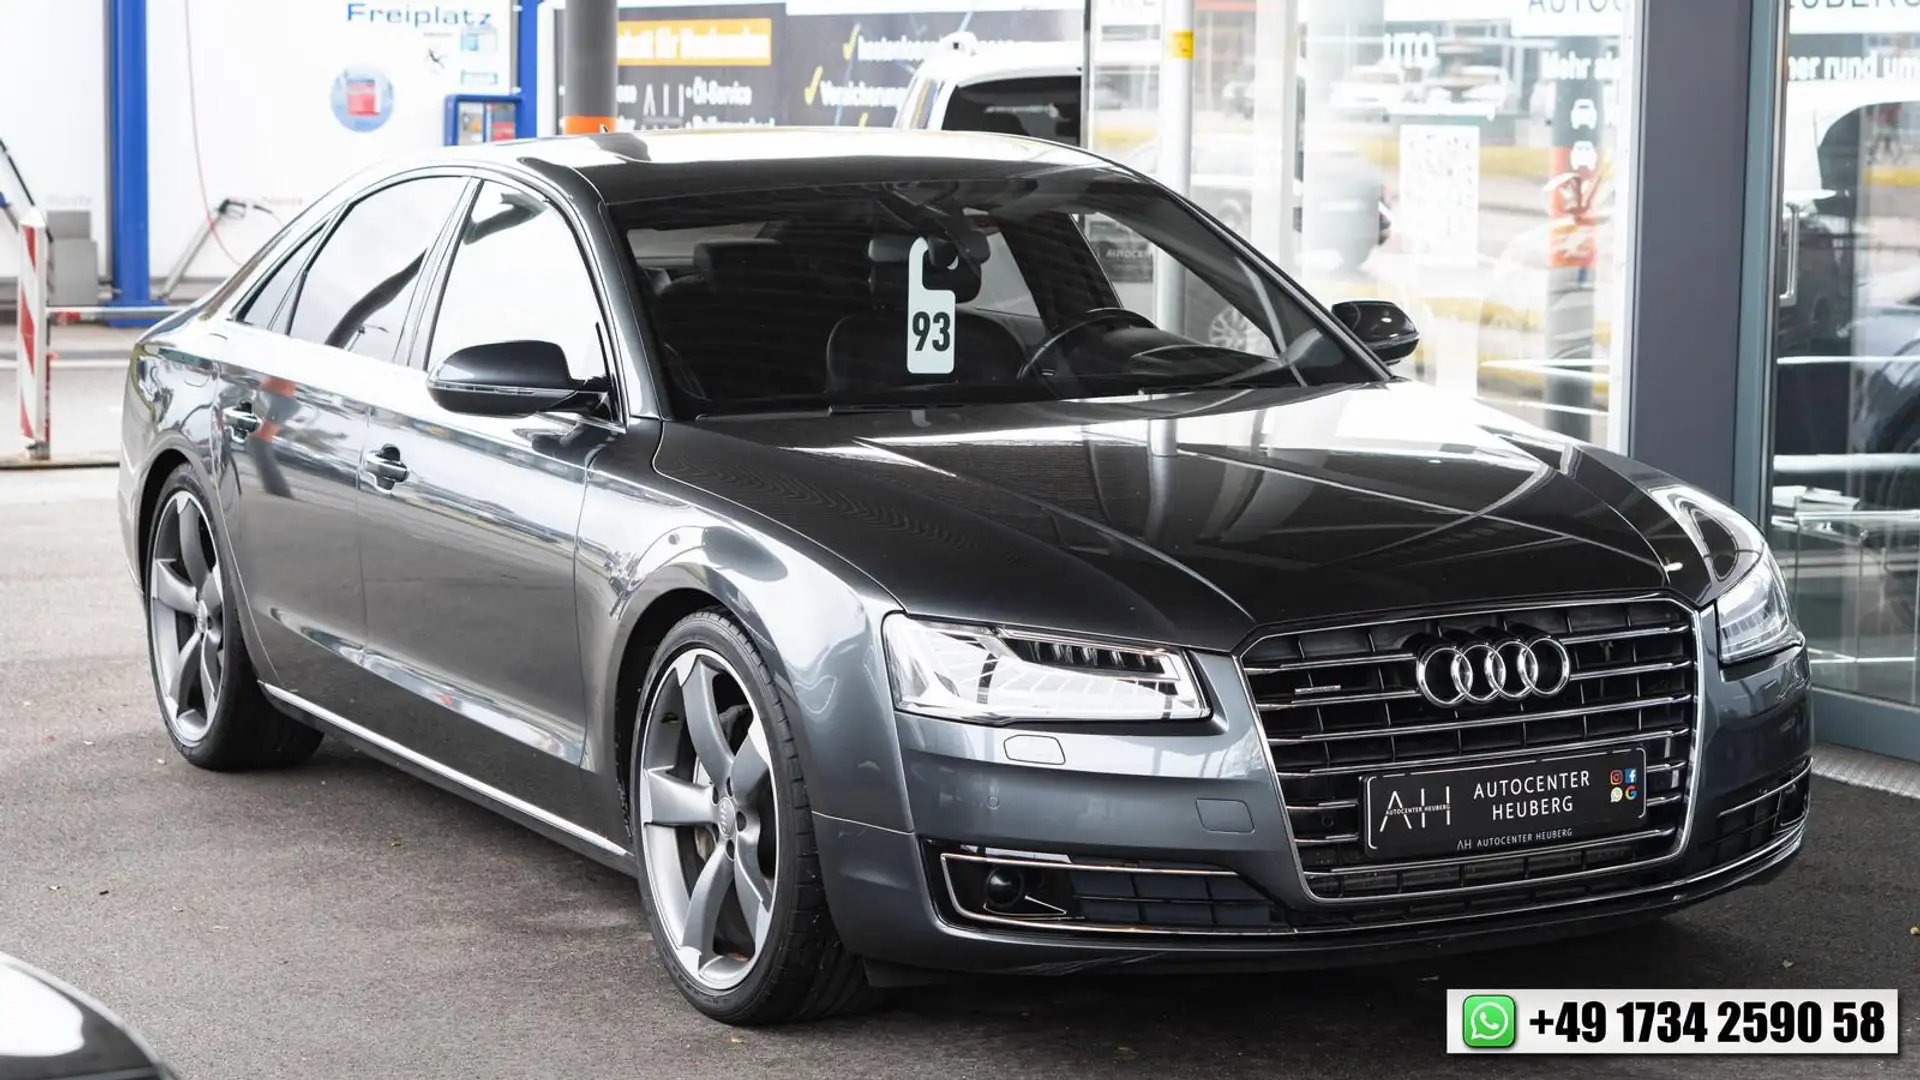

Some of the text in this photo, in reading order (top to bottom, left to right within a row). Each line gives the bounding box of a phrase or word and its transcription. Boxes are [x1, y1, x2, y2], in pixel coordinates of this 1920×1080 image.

[346, 2, 492, 28] Freiplatz
[1823, 50, 1877, 80] rund
[912, 311, 950, 352] 93
[1473, 770, 1590, 800] AUTOCENTER
[1380, 786, 1450, 832] AH
[1492, 796, 1574, 821] HEUBERG
[1457, 827, 1573, 851] AH AUTOCENTER HEUBERG
